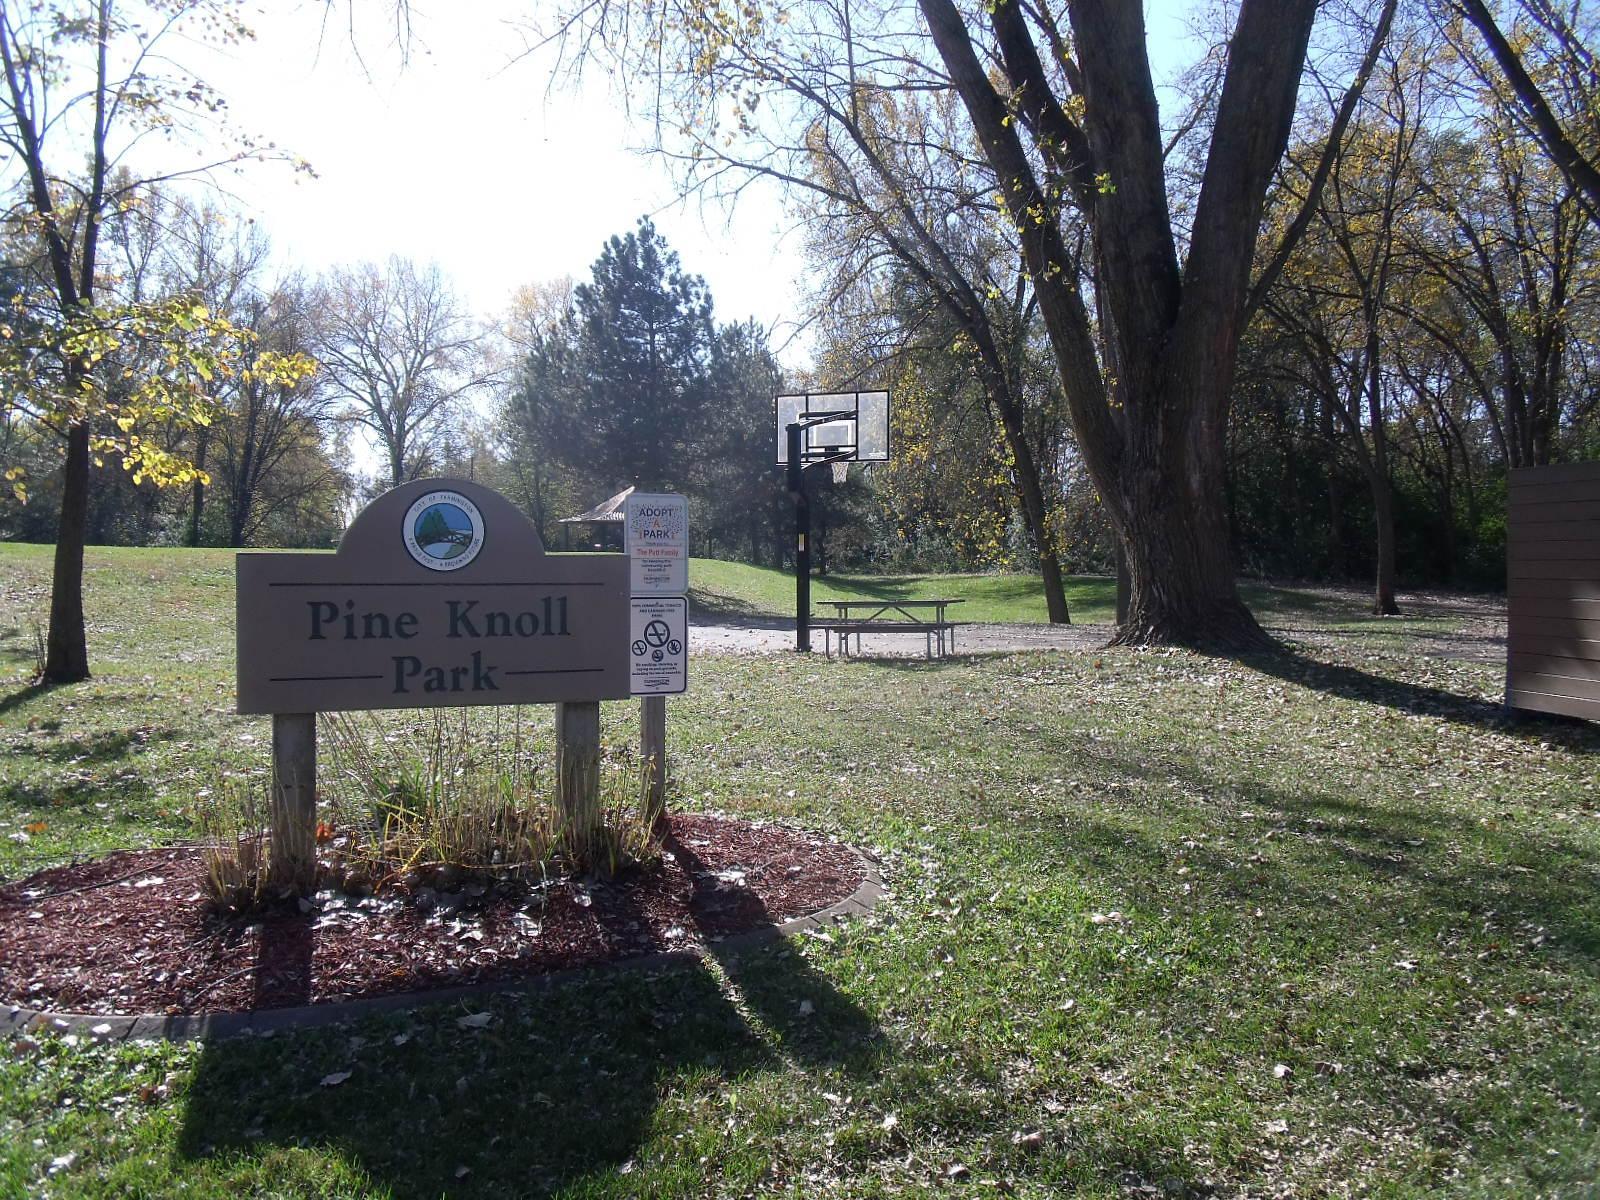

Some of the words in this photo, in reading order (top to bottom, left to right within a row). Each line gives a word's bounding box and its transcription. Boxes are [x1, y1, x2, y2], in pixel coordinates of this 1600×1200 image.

[639, 508, 672, 517] ADOPT
[653, 519, 661, 528] A
[643, 530, 670, 539] PARK
[306, 599, 420, 640] Pine
[444, 595, 571, 638] Knoll
[391, 650, 500, 694] Park
